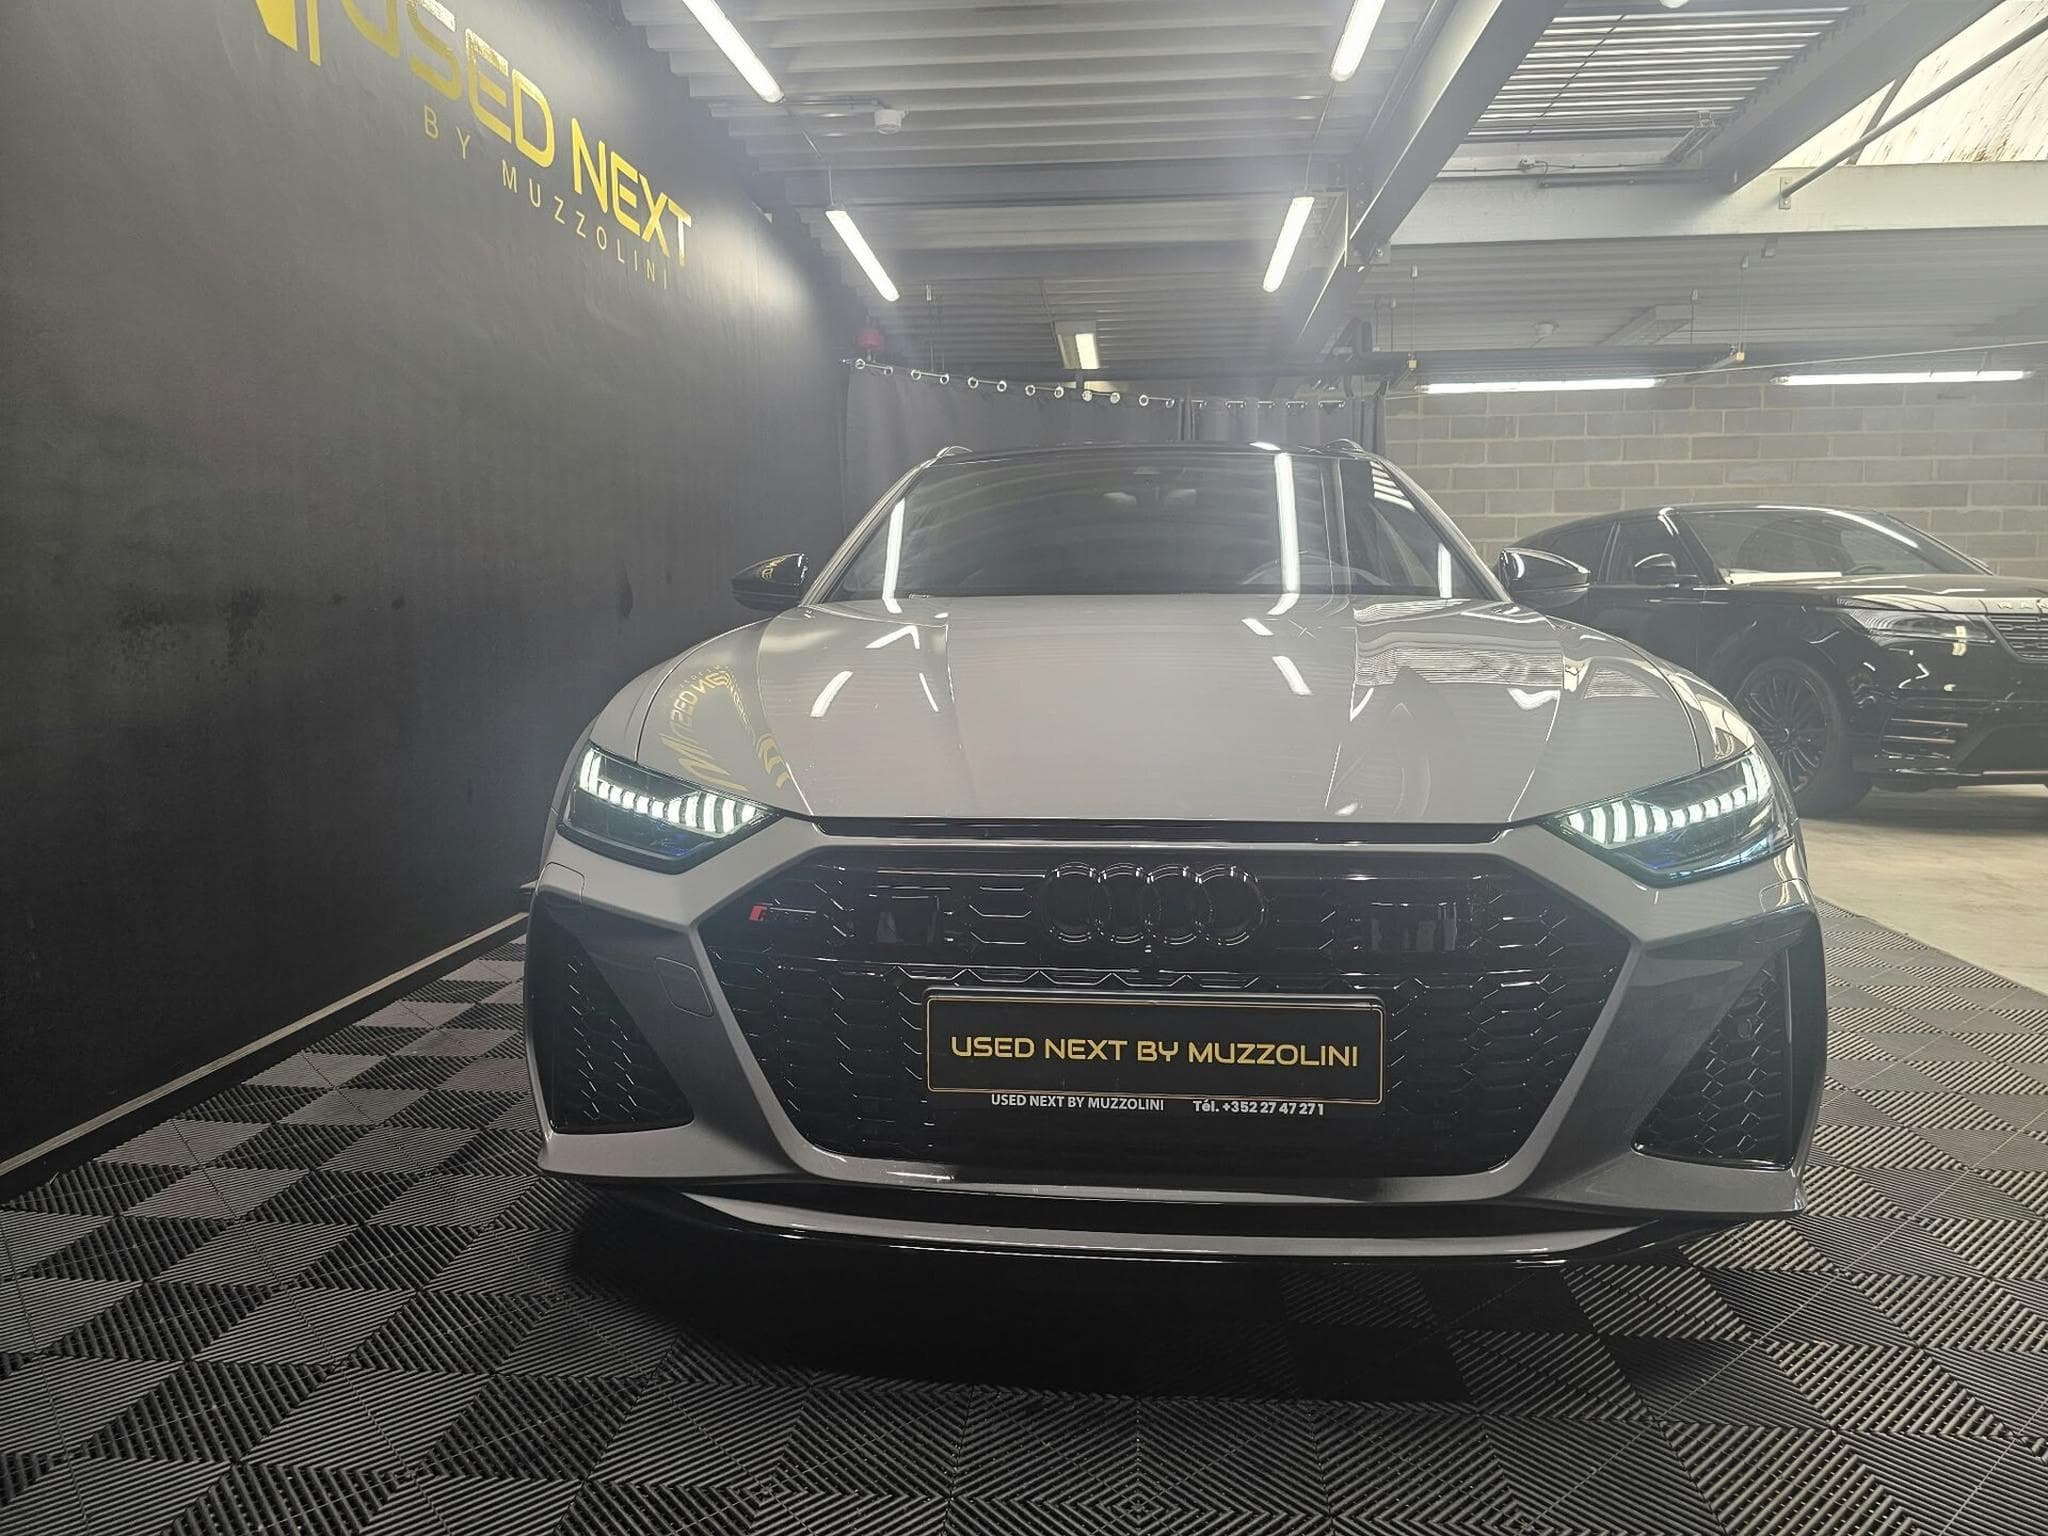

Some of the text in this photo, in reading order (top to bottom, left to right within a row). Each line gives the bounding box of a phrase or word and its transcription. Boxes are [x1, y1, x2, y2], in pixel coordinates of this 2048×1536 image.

[424, 105, 668, 290] BY MUZZOLINI
[571, 117, 692, 267] NEXT
[951, 1036, 1358, 1067] USED NEXT BY MUZZOLINI
[991, 1093, 1164, 1111] USED NEXT BY MUZZOLINI
[1192, 1098, 1220, 1112] Tél.
[1222, 1101, 1258, 1113] +352
[1260, 1101, 1277, 1114] 27
[1279, 1102, 1297, 1115] 47
